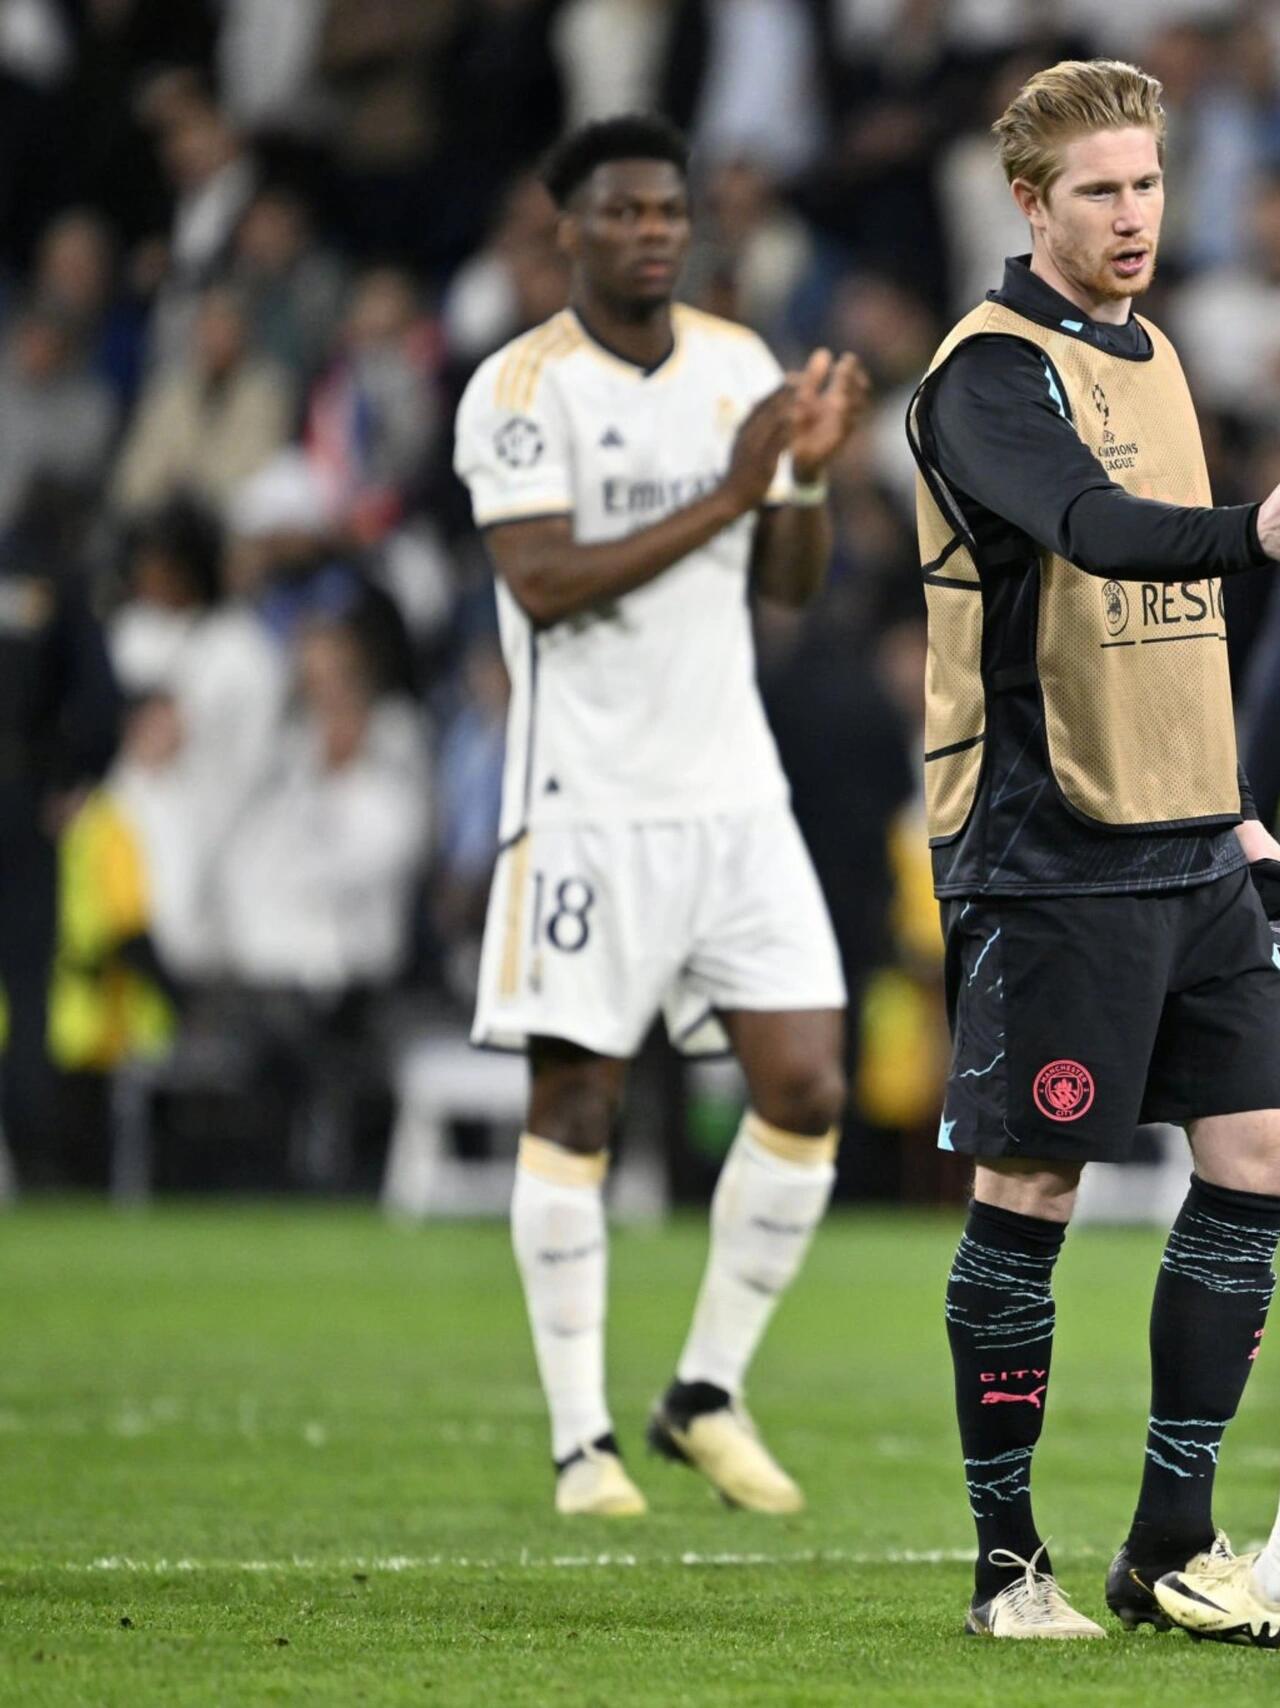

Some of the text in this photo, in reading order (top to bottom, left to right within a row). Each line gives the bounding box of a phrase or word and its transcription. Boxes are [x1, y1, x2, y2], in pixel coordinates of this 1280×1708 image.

[532, 871, 594, 954] 18
[1041, 1064, 1088, 1084] MANCHESTER
[1055, 1109, 1074, 1117] CITY
[980, 1369, 1046, 1382] CITY
